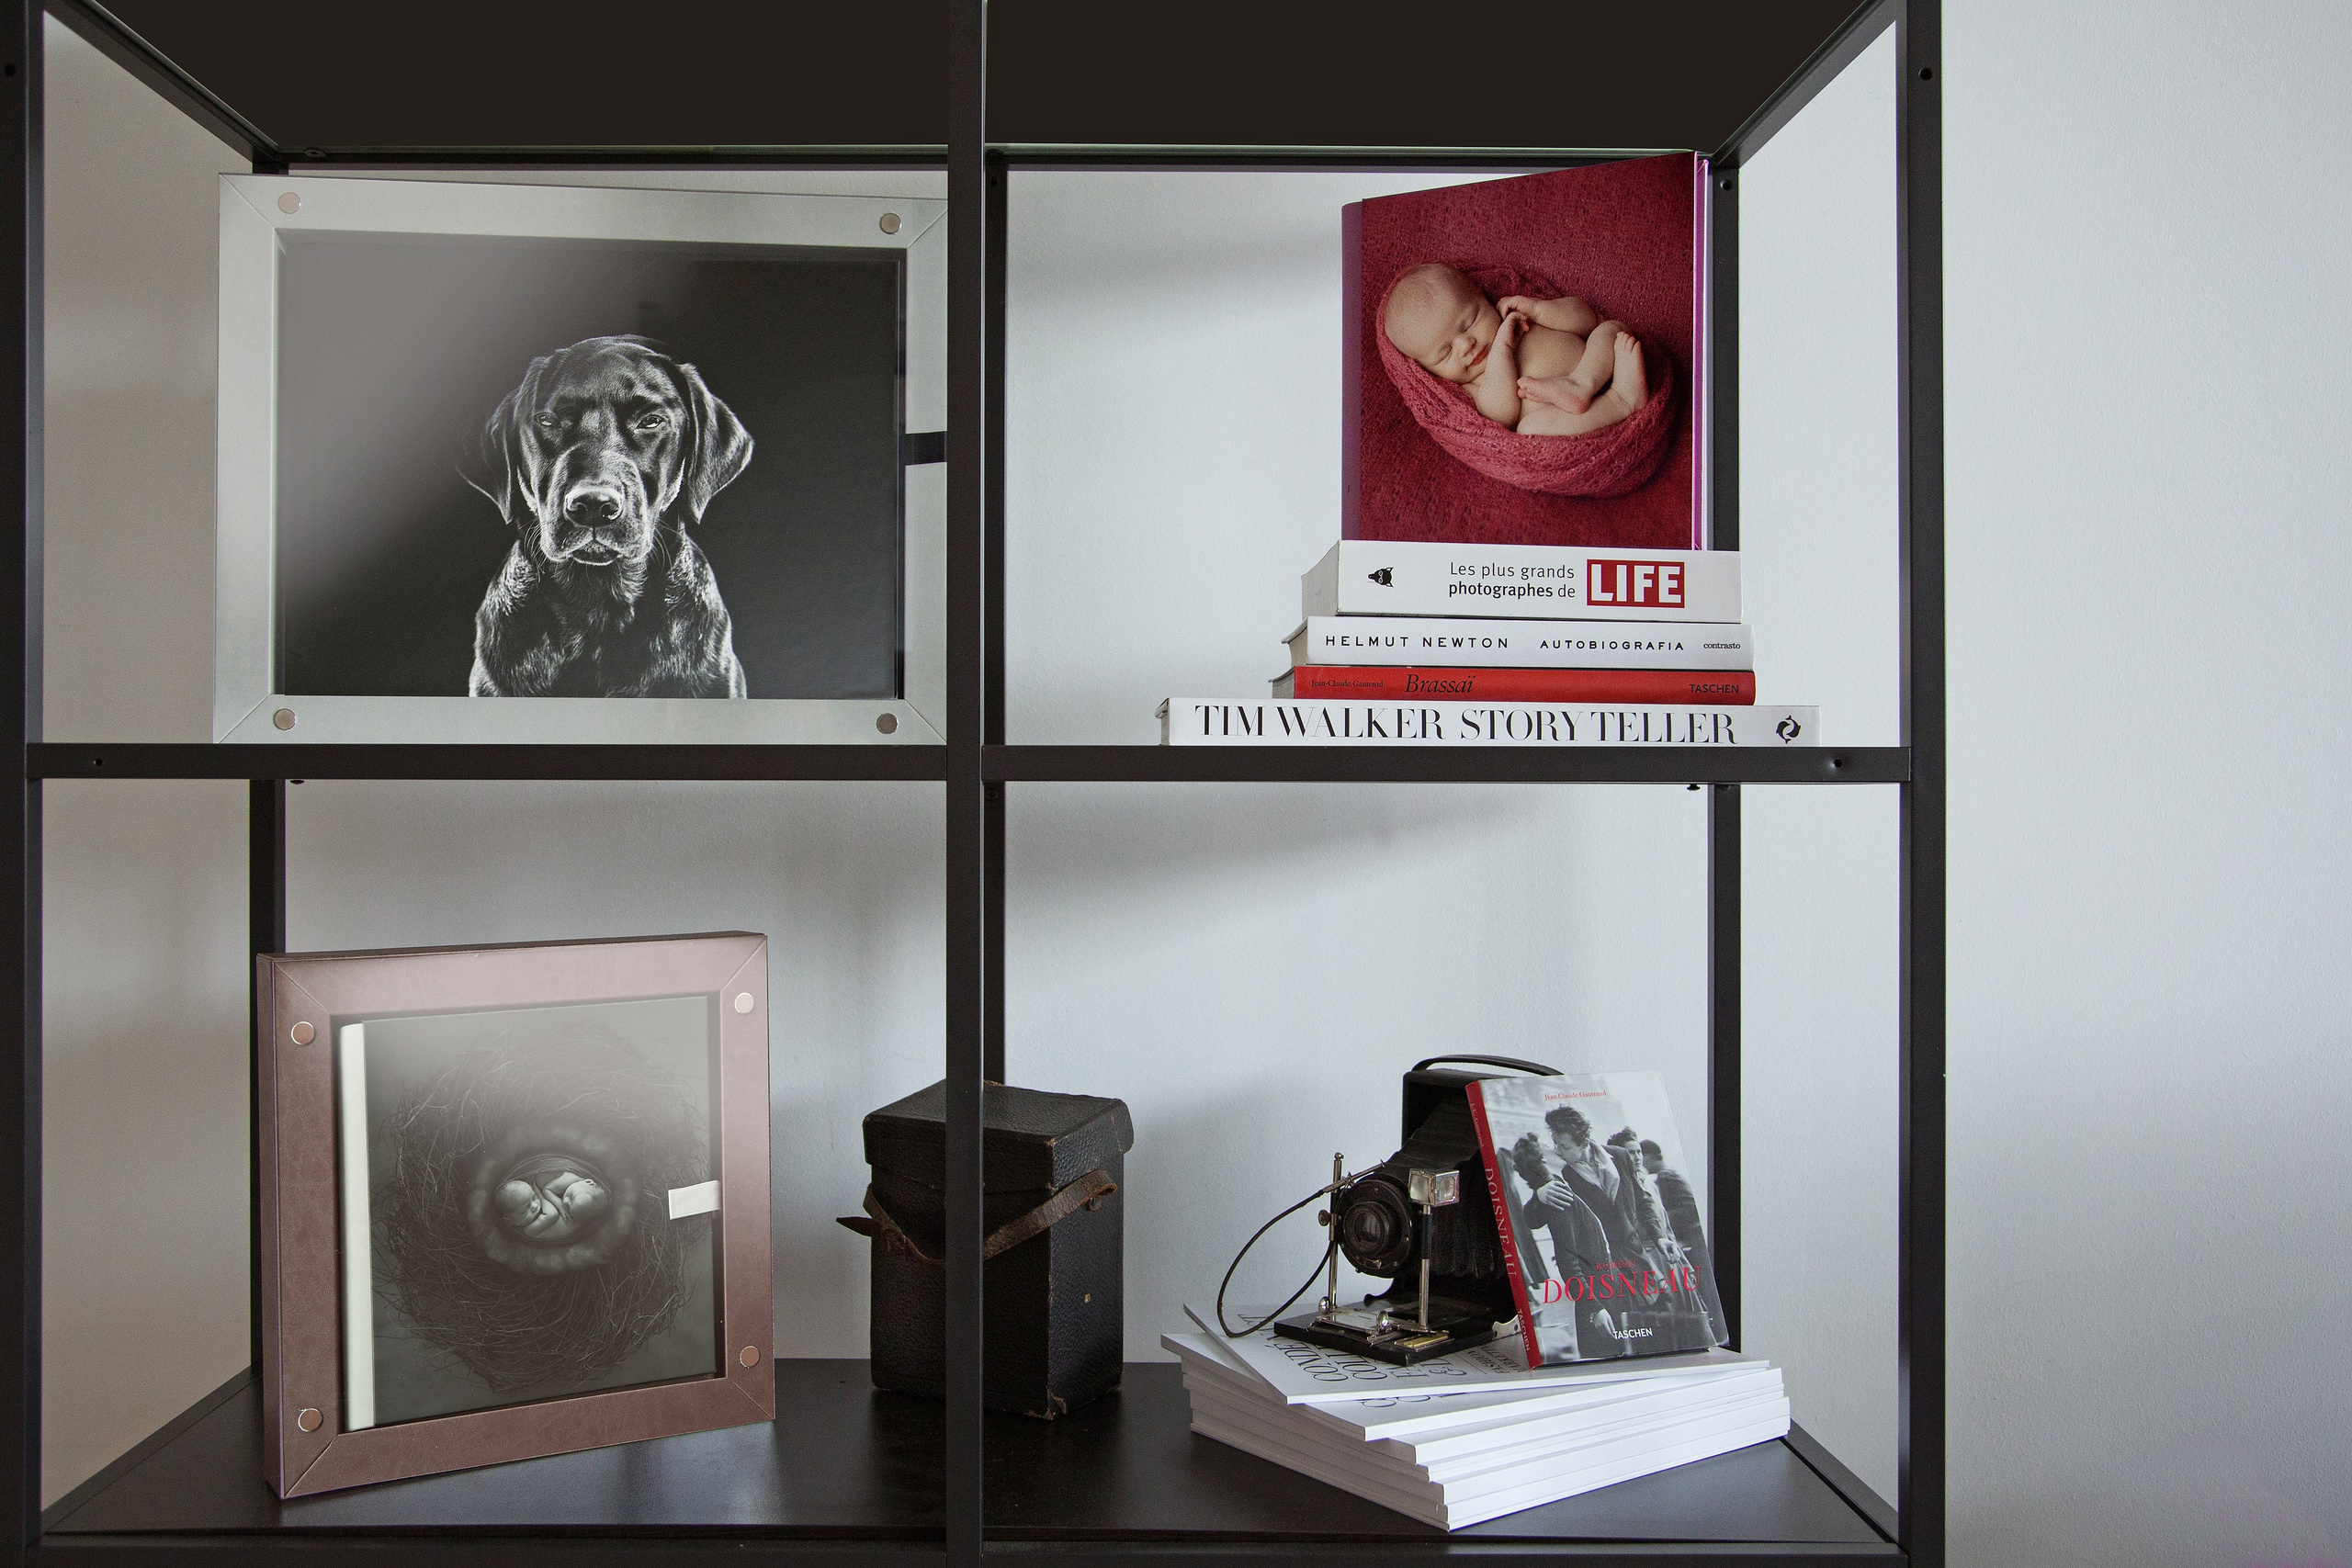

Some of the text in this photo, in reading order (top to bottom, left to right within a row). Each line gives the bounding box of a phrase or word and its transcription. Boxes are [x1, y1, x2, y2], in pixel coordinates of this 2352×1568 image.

[1450, 561, 1575, 581] Les plus grands
[1449, 581, 1576, 600] photographes de
[1590, 563, 1682, 604] LIFE
[1326, 636, 1741, 651] HELMUT NEWTON AUTOBIOGRAFIA contrasto
[1311, 673, 1739, 694] Jean-Claude Gautrand Brassaï TASCHEN
[1194, 705, 1739, 745] TIM WALKER STORY TELLER
[1595, 1259, 1637, 1270] ROBERT
[1543, 1266, 1702, 1304] DOISNEAU
[1518, 1308, 1531, 1351] TASCHEN
[1612, 1327, 1653, 1340] TASCHEN
